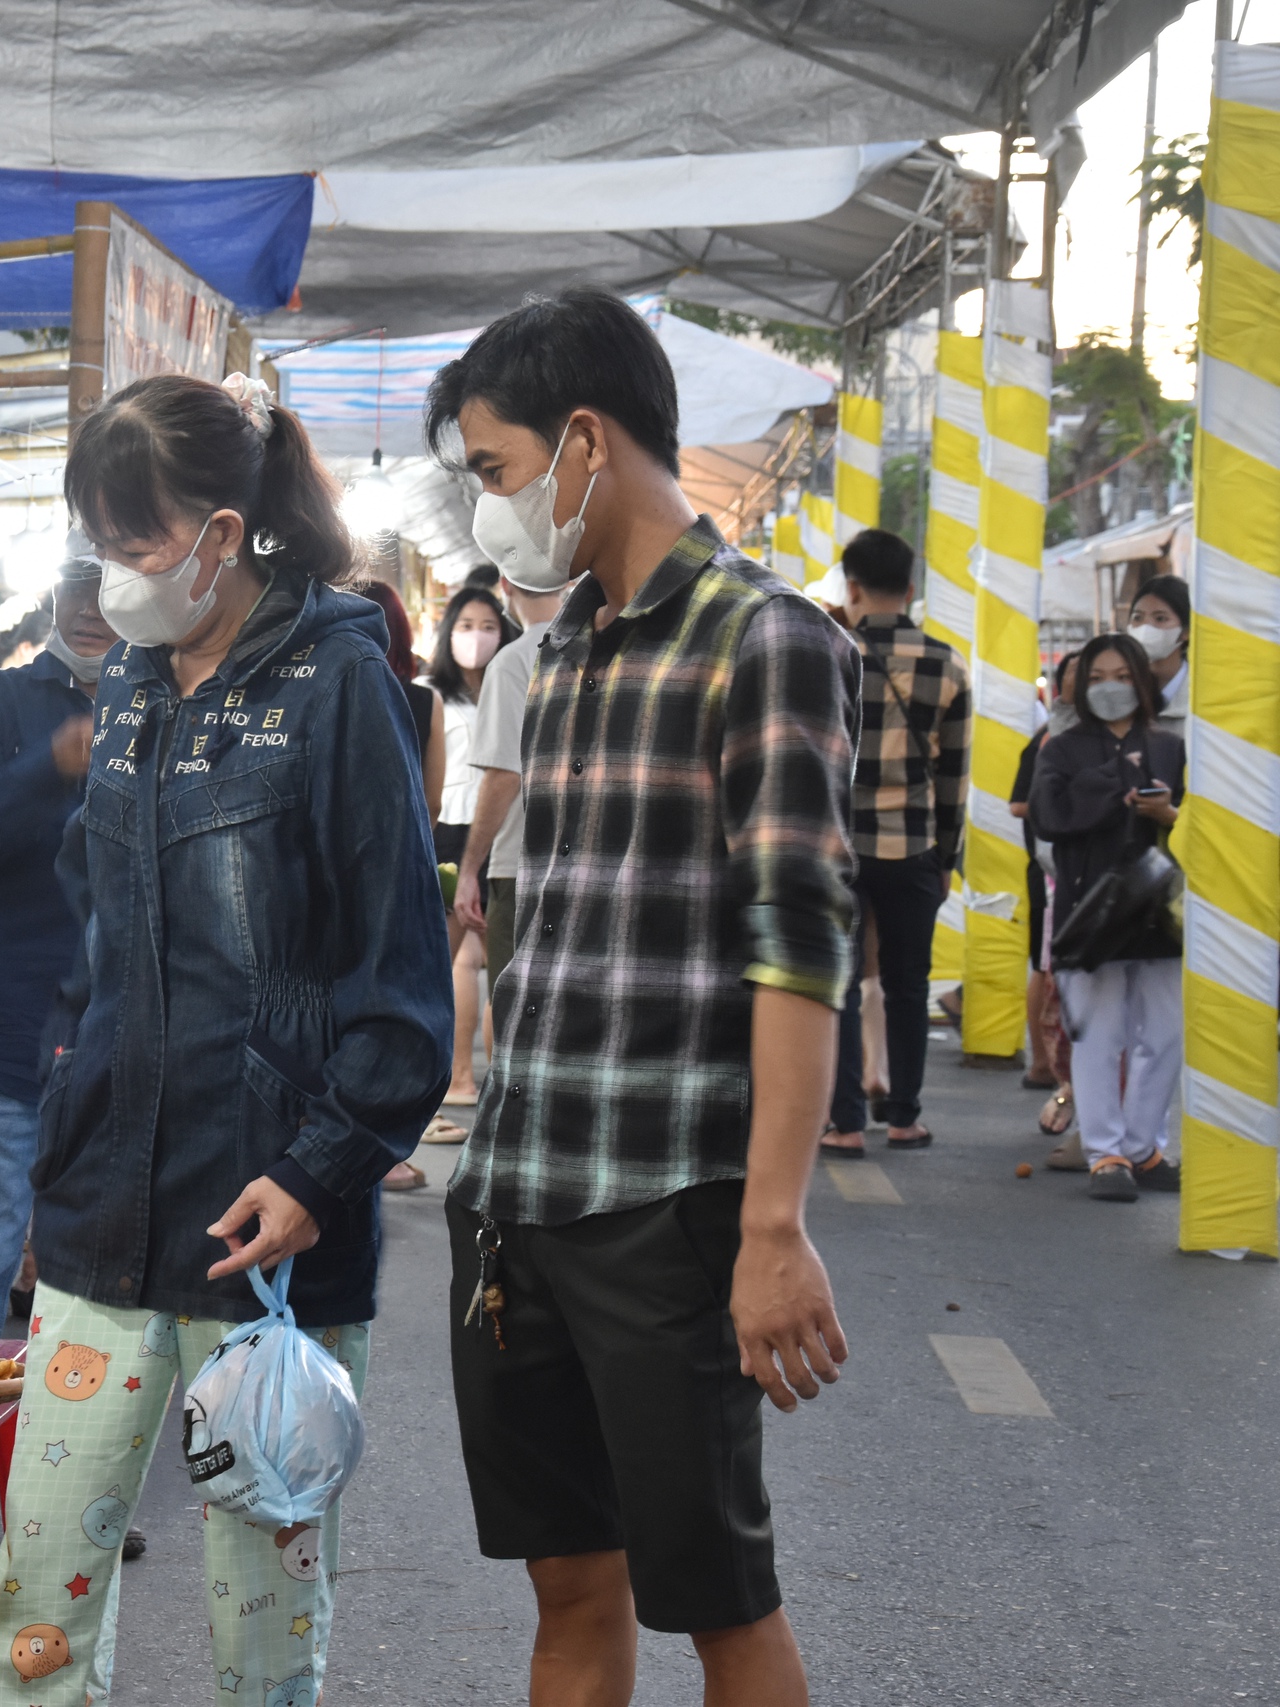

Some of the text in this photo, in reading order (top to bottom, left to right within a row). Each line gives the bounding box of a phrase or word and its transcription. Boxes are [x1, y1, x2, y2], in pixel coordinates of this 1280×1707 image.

[105, 664, 126, 678] FEN
[270, 665, 317, 678] FENDI
[241, 732, 288, 747] FENDI
[106, 758, 136, 775] FEN
[175, 759, 211, 774] FENDI
[231, 1479, 260, 1499] Always
[239, 1593, 276, 1618] LUCKY
